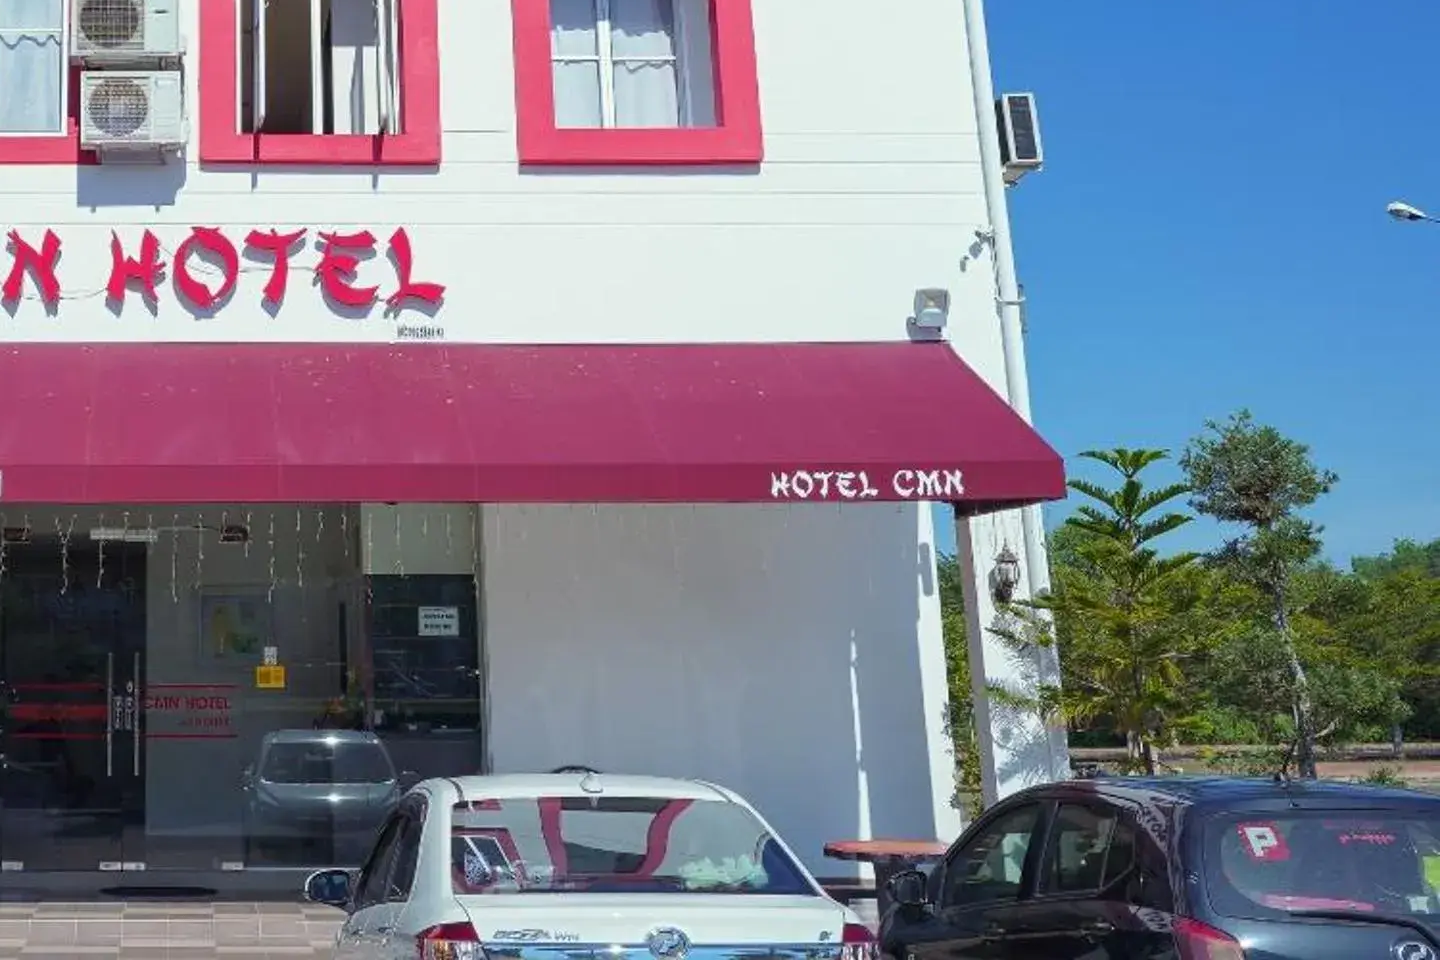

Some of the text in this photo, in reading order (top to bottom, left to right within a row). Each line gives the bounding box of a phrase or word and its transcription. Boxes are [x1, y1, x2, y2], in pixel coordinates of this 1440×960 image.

[106, 227, 446, 314] HOTEL
[771, 469, 964, 498] HOTEL CMN
[1243, 827, 1278, 858] P
